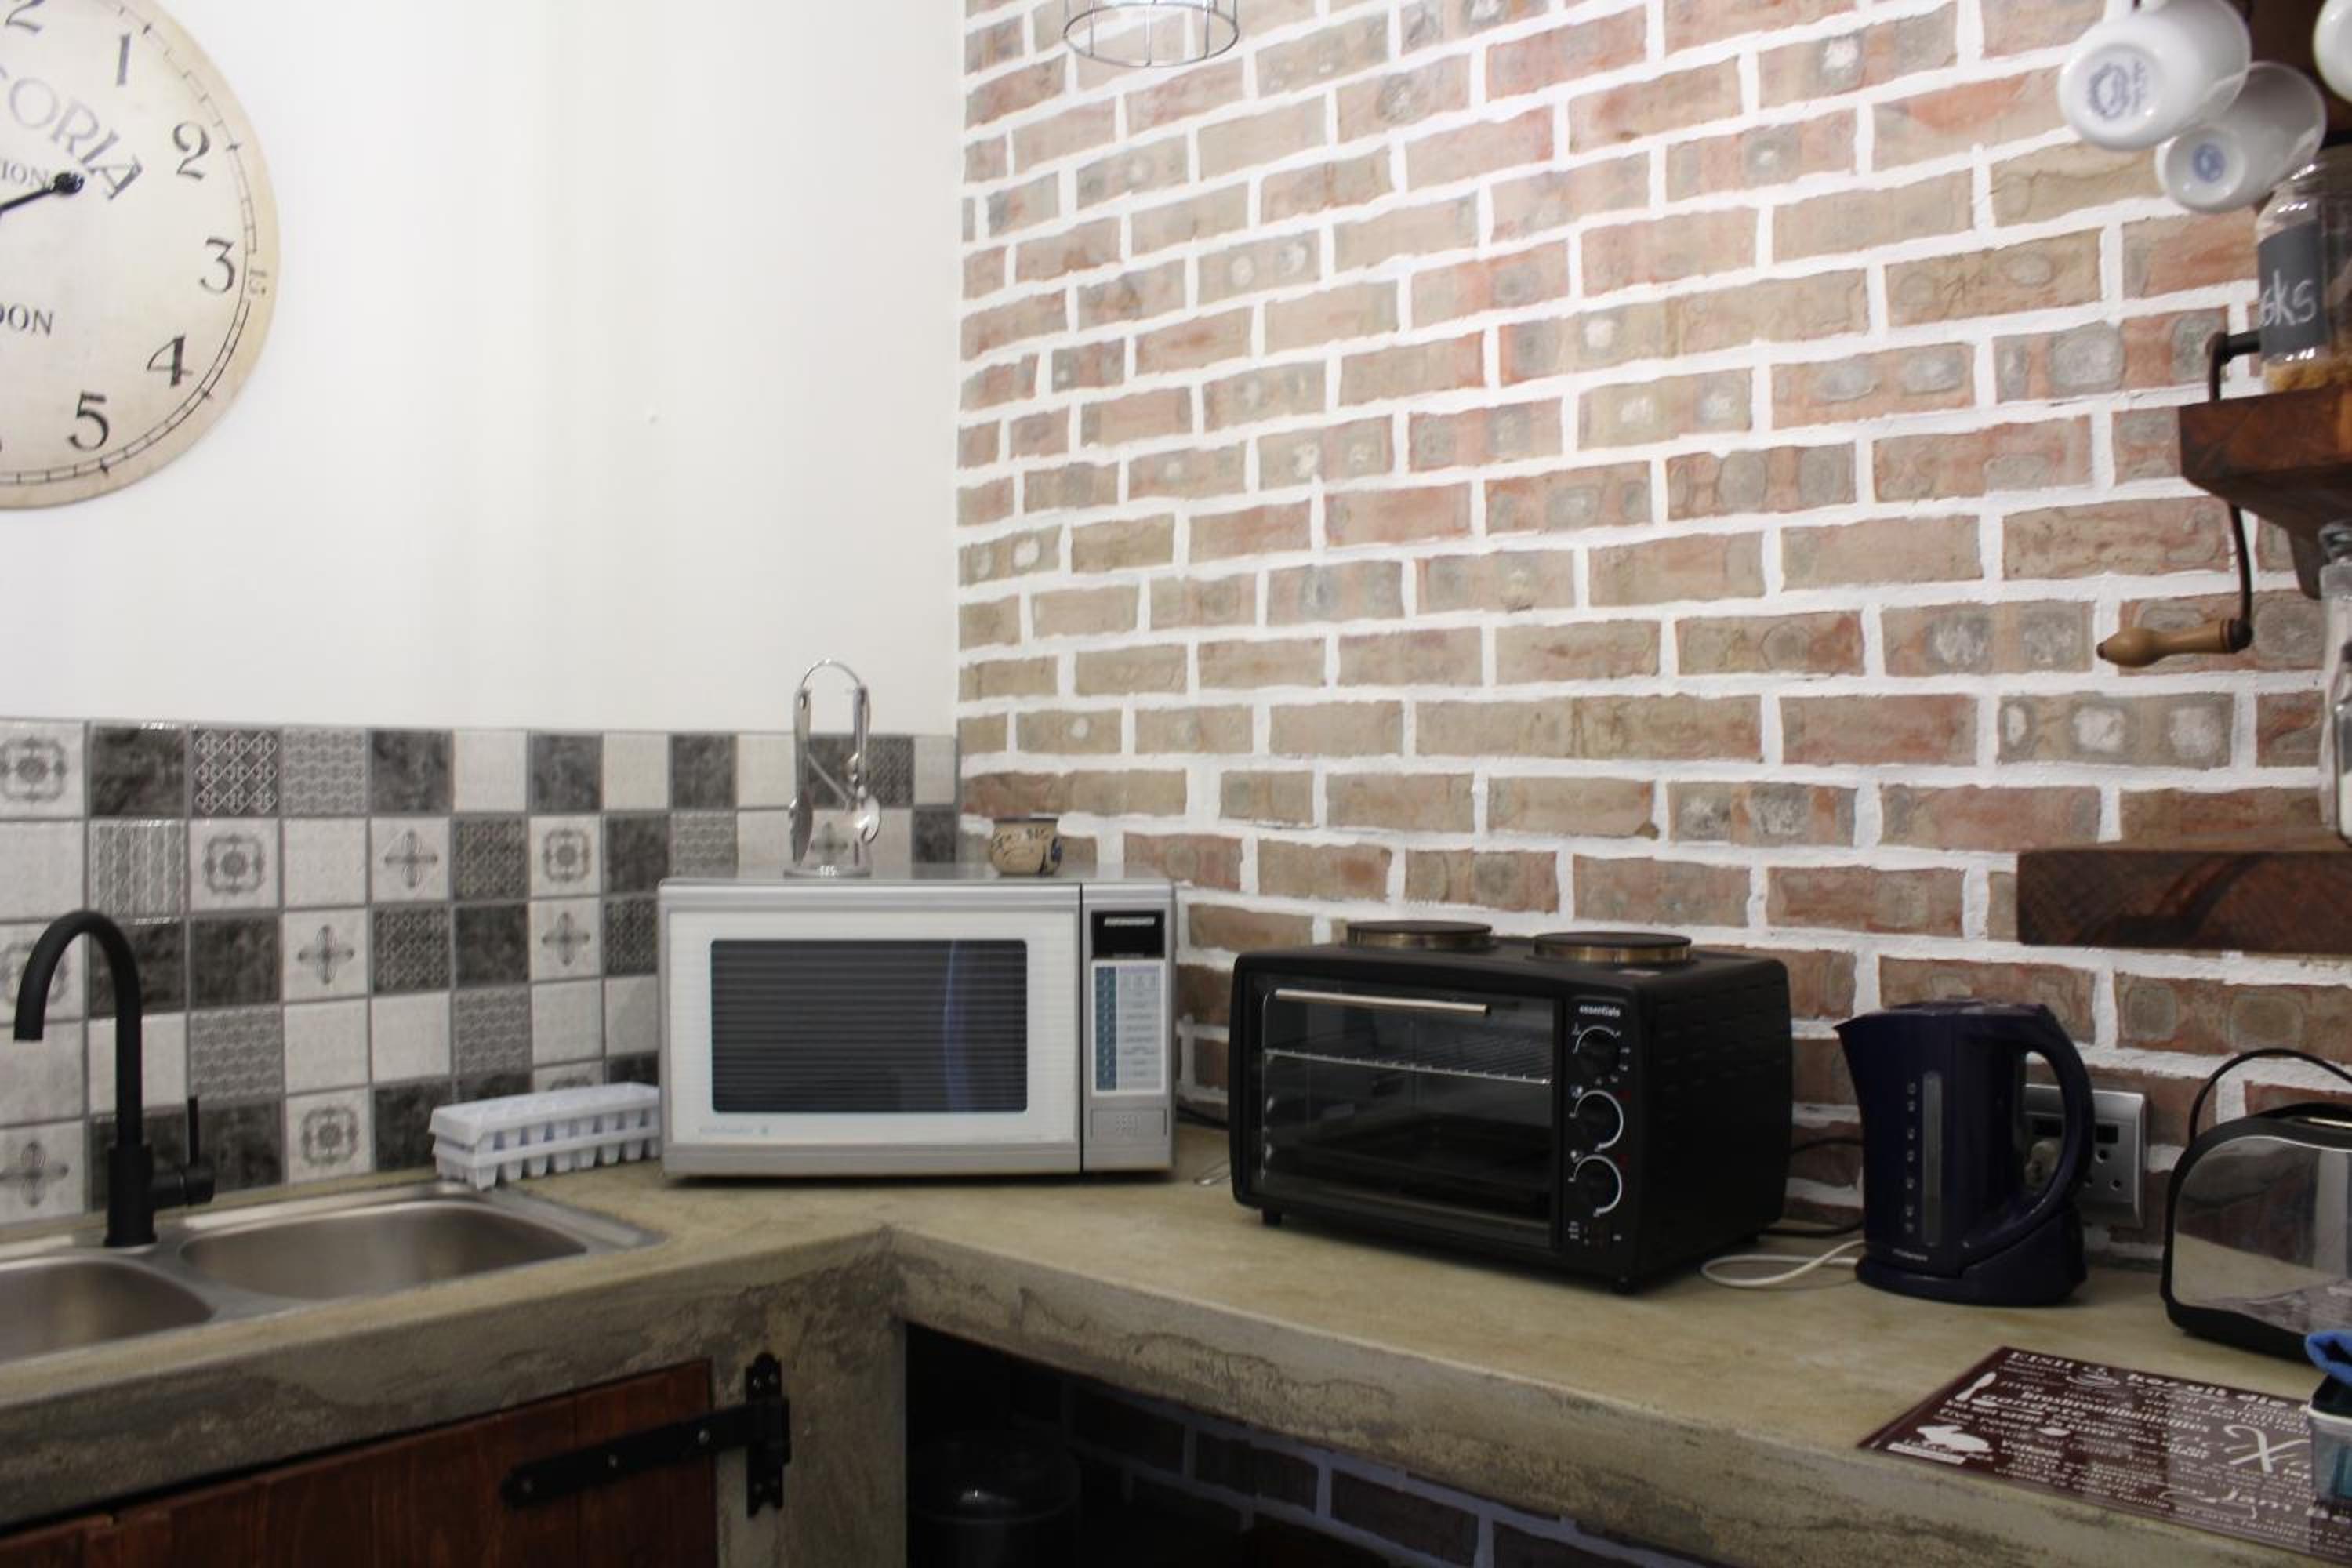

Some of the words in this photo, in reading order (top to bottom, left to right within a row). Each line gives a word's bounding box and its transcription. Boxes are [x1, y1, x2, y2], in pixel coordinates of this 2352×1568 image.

[116, 33, 131, 86] 1
[0, 65, 143, 200] ORIA
[172, 121, 210, 180] 2
[200, 237, 236, 294] 3
[147, 334, 194, 387] 4
[68, 390, 109, 452] 5
